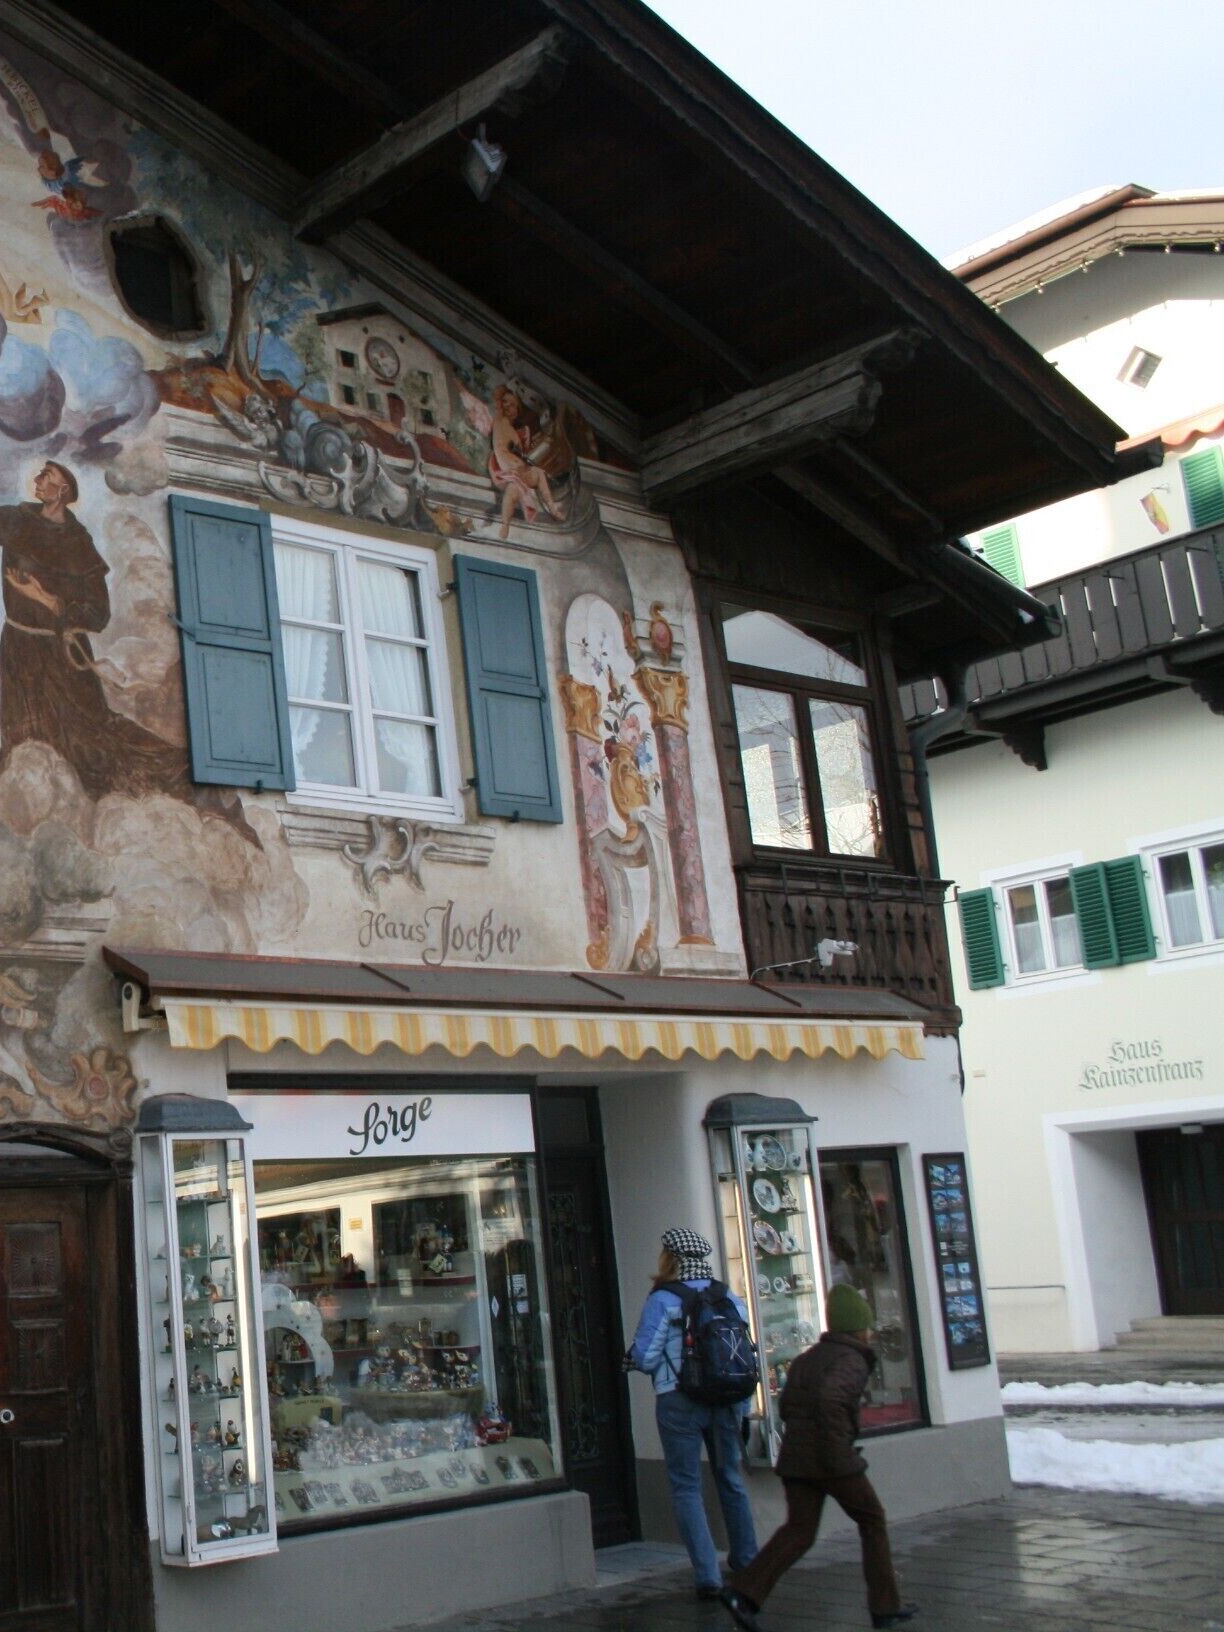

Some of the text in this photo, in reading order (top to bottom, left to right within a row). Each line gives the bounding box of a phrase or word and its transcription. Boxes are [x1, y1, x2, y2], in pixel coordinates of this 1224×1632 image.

[358, 899, 521, 967] Haus Jocher
[1078, 1058, 1204, 1090] Kainzenfranz
[1106, 1039, 1163, 1064] Haus
[347, 1096, 432, 1156] Sorge
